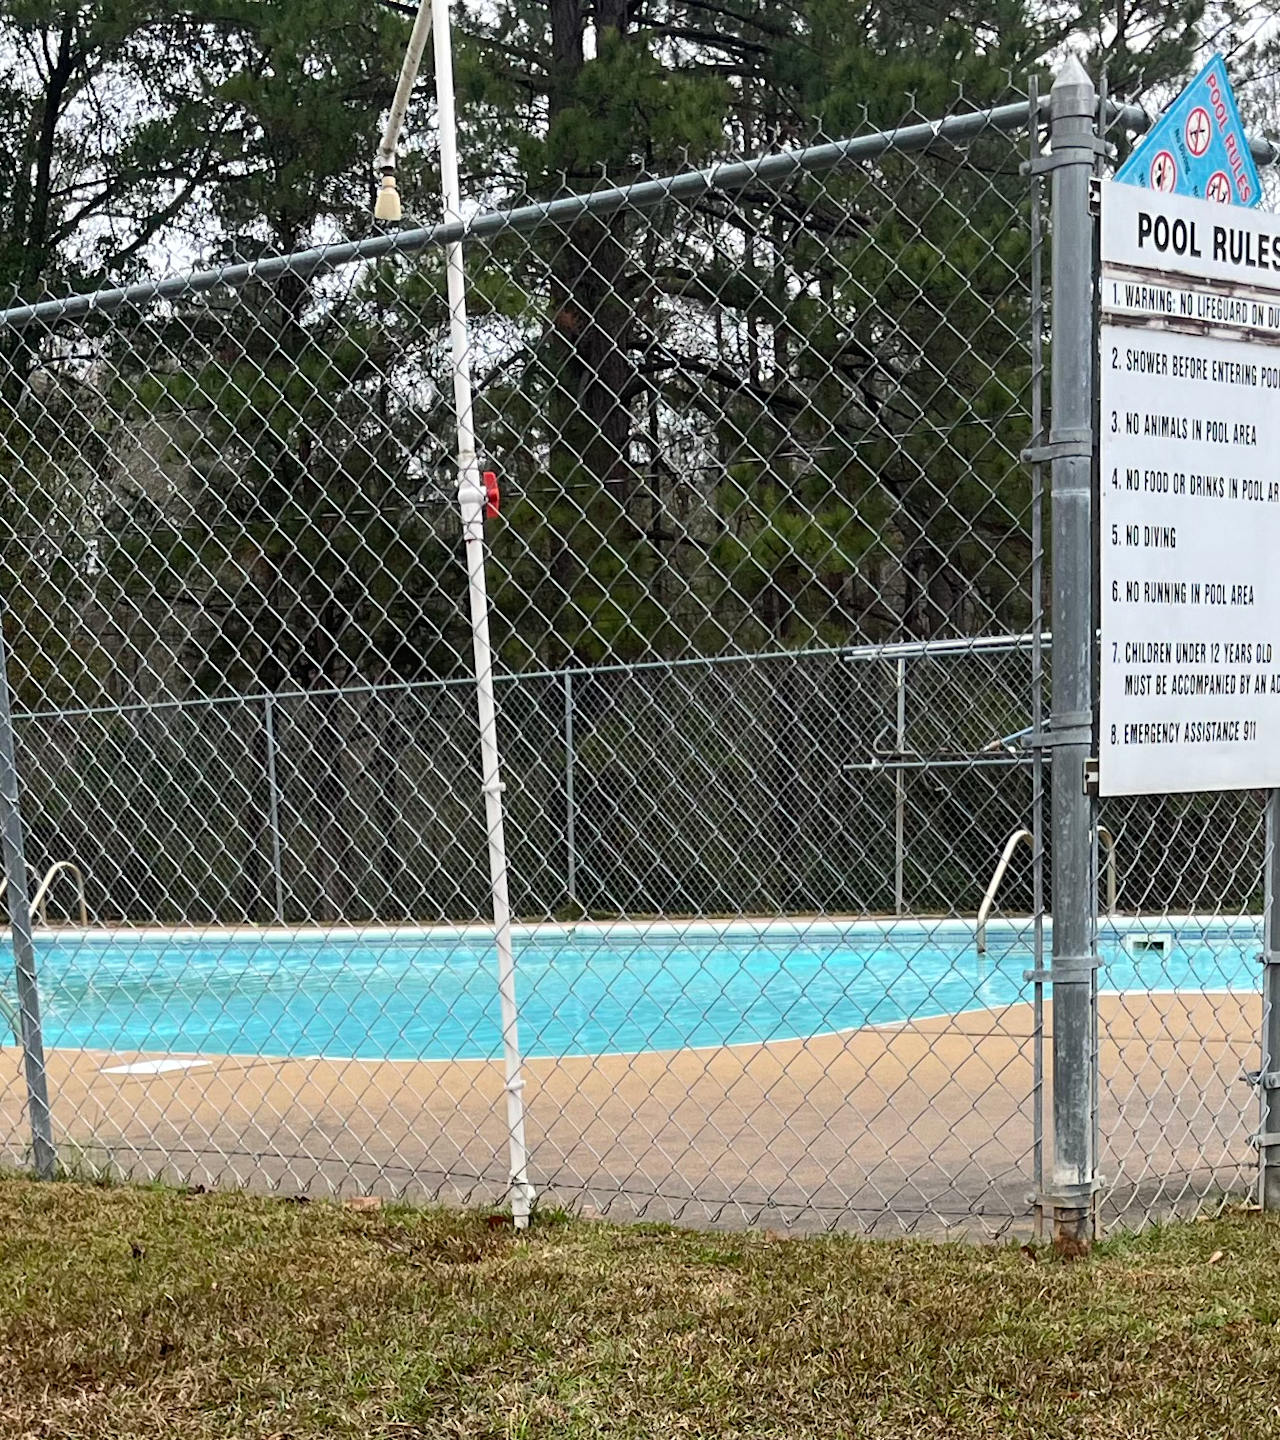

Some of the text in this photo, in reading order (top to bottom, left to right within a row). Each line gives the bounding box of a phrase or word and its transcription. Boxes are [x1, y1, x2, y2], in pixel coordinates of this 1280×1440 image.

[1206, 73, 1251, 202] POOL RULES
[1138, 211, 1202, 258] POOL
[1112, 282, 1121, 305] 1.
[1125, 284, 1176, 313] WARNING:
[1180, 292, 1193, 316] NO
[1197, 295, 1248, 324] LIFEGUARD
[1252, 304, 1264, 327] ON
[1111, 346, 1122, 370] 2.
[1126, 348, 1168, 375] SHOWER
[1172, 354, 1208, 381] BEFORE
[1212, 360, 1257, 387] ENTERING
[1111, 410, 1257, 446] 3. NO ANIMALS IN POOL AREA
[1111, 467, 1122, 490] 4.
[1126, 468, 1140, 492] NO
[1144, 470, 1169, 494] FOOD
[1173, 472, 1186, 495] OR
[1190, 474, 1225, 499] DRINKS
[1228, 478, 1238, 499] IN
[1242, 479, 1264, 502] POOL
[1111, 523, 1176, 549] 5. NO DIVING
[1111, 579, 1254, 606] 6. NO RUNNING IN POOL AREA
[1112, 641, 1272, 664] 7. CHILDREN UNDER 12 YEARS OLD
[1124, 674, 1152, 696] MUST
[1155, 674, 1168, 696] BE
[1171, 674, 1236, 696] ACCOMPANIED
[1239, 674, 1251, 695] BY
[1253, 674, 1267, 694] AN
[1110, 720, 1257, 746] 8. EMERGENCY ASSISTANCE 911
